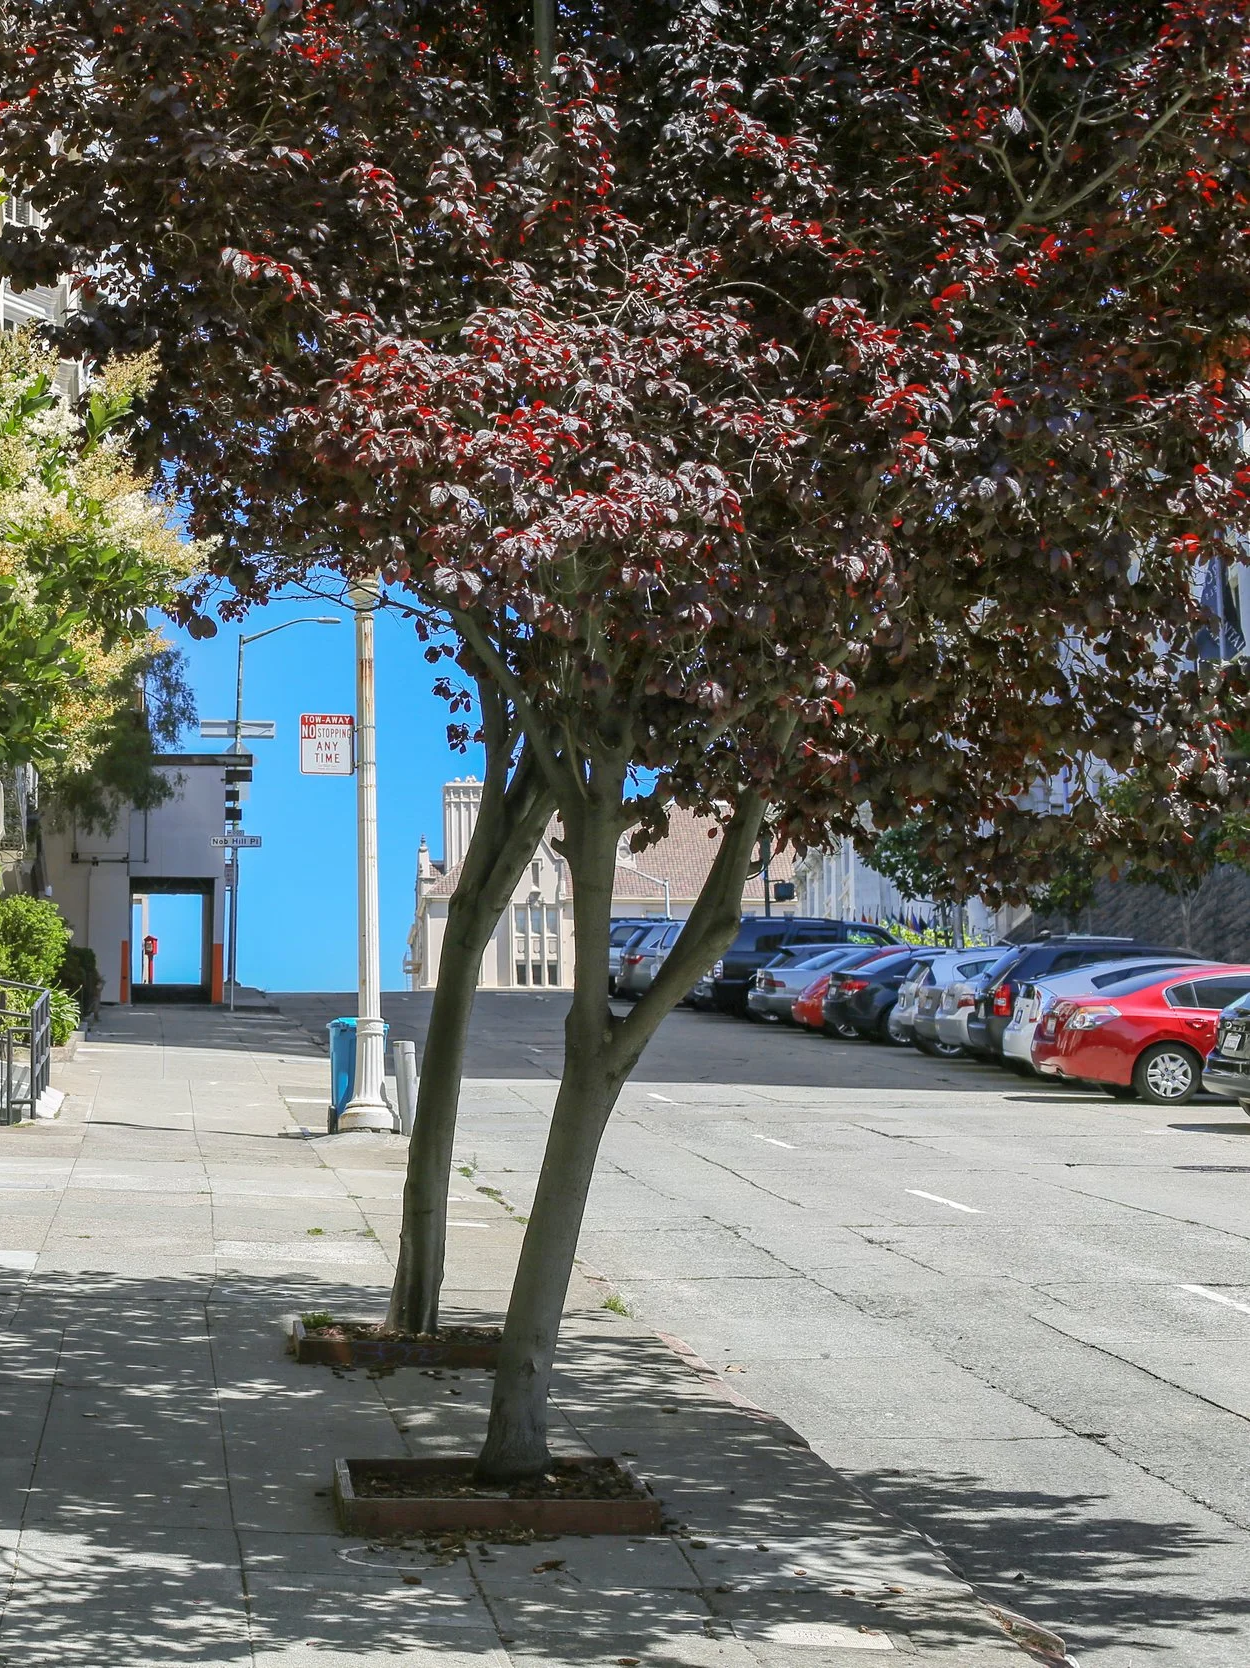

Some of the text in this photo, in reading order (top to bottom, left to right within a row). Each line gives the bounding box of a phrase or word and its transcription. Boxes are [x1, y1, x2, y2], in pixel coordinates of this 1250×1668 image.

[304, 715, 350, 724] TOW-AWAY
[302, 724, 351, 738] NO STOPPING
[316, 741, 339, 751] ANY
[315, 753, 340, 763] TIME
